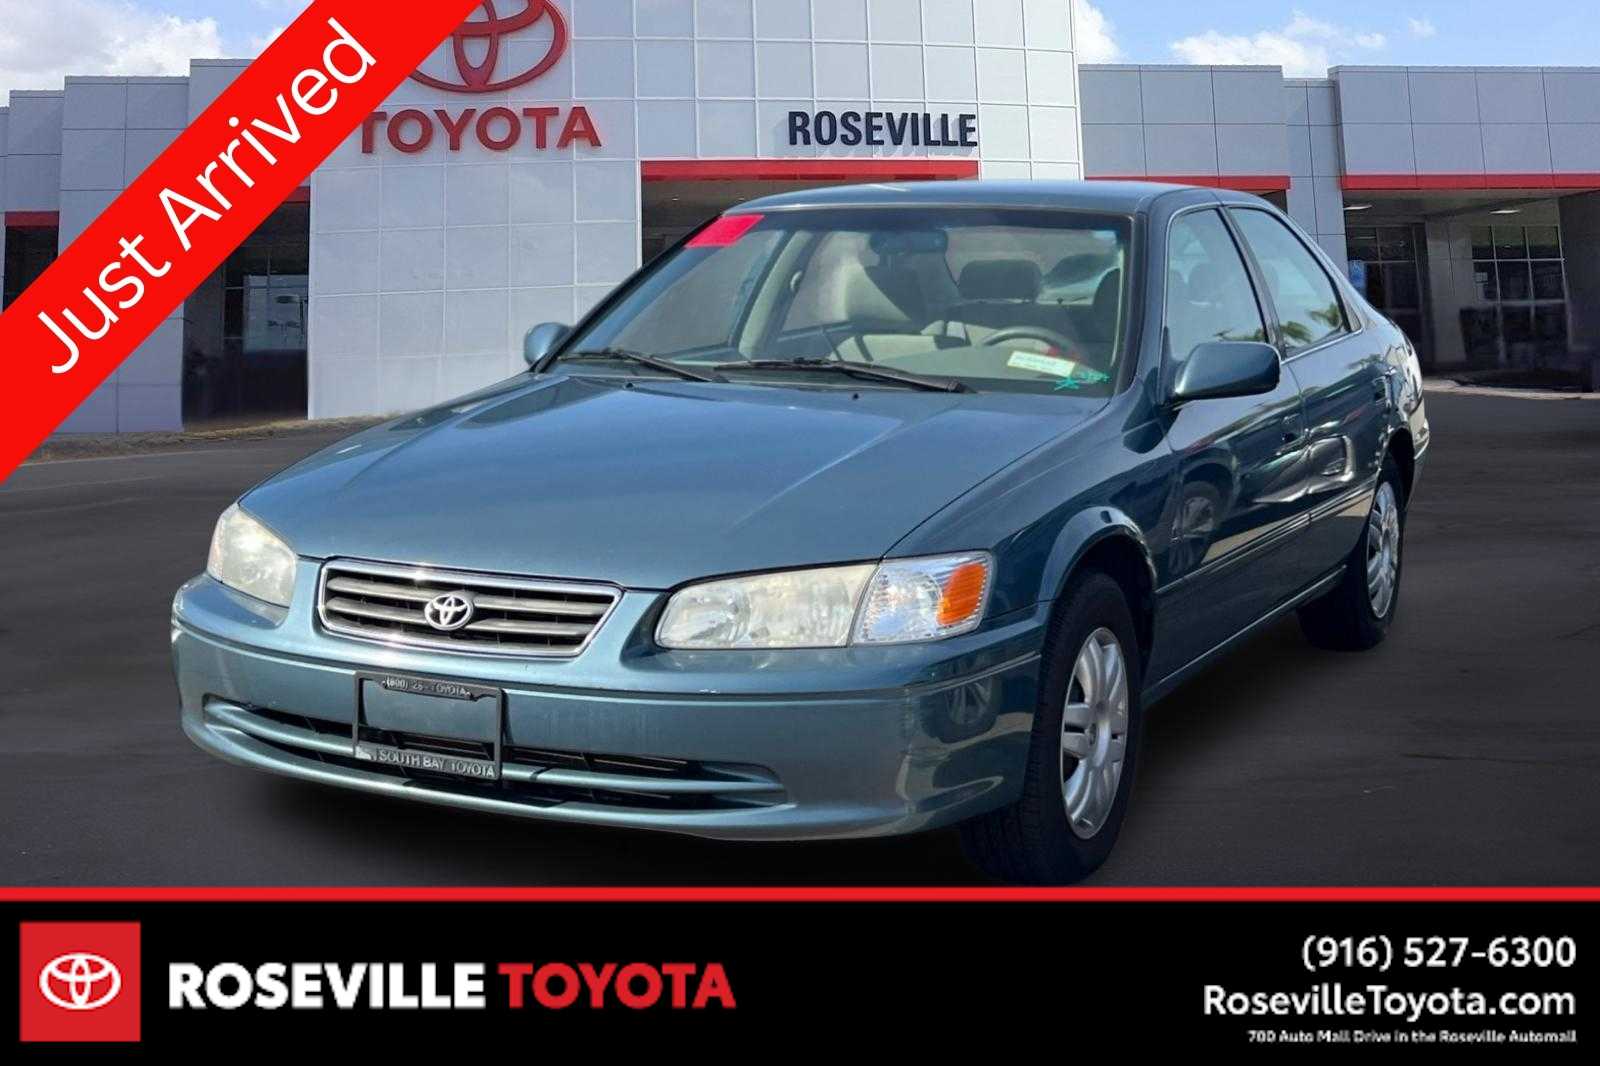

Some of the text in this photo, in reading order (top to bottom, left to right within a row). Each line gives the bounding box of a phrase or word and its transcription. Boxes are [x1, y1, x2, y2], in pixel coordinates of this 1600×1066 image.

[361, 107, 602, 153] TOYOTA
[788, 111, 978, 147] ROSEVILLE
[378, 748, 421, 767] SOUTH
[422, 755, 445, 770] BAY
